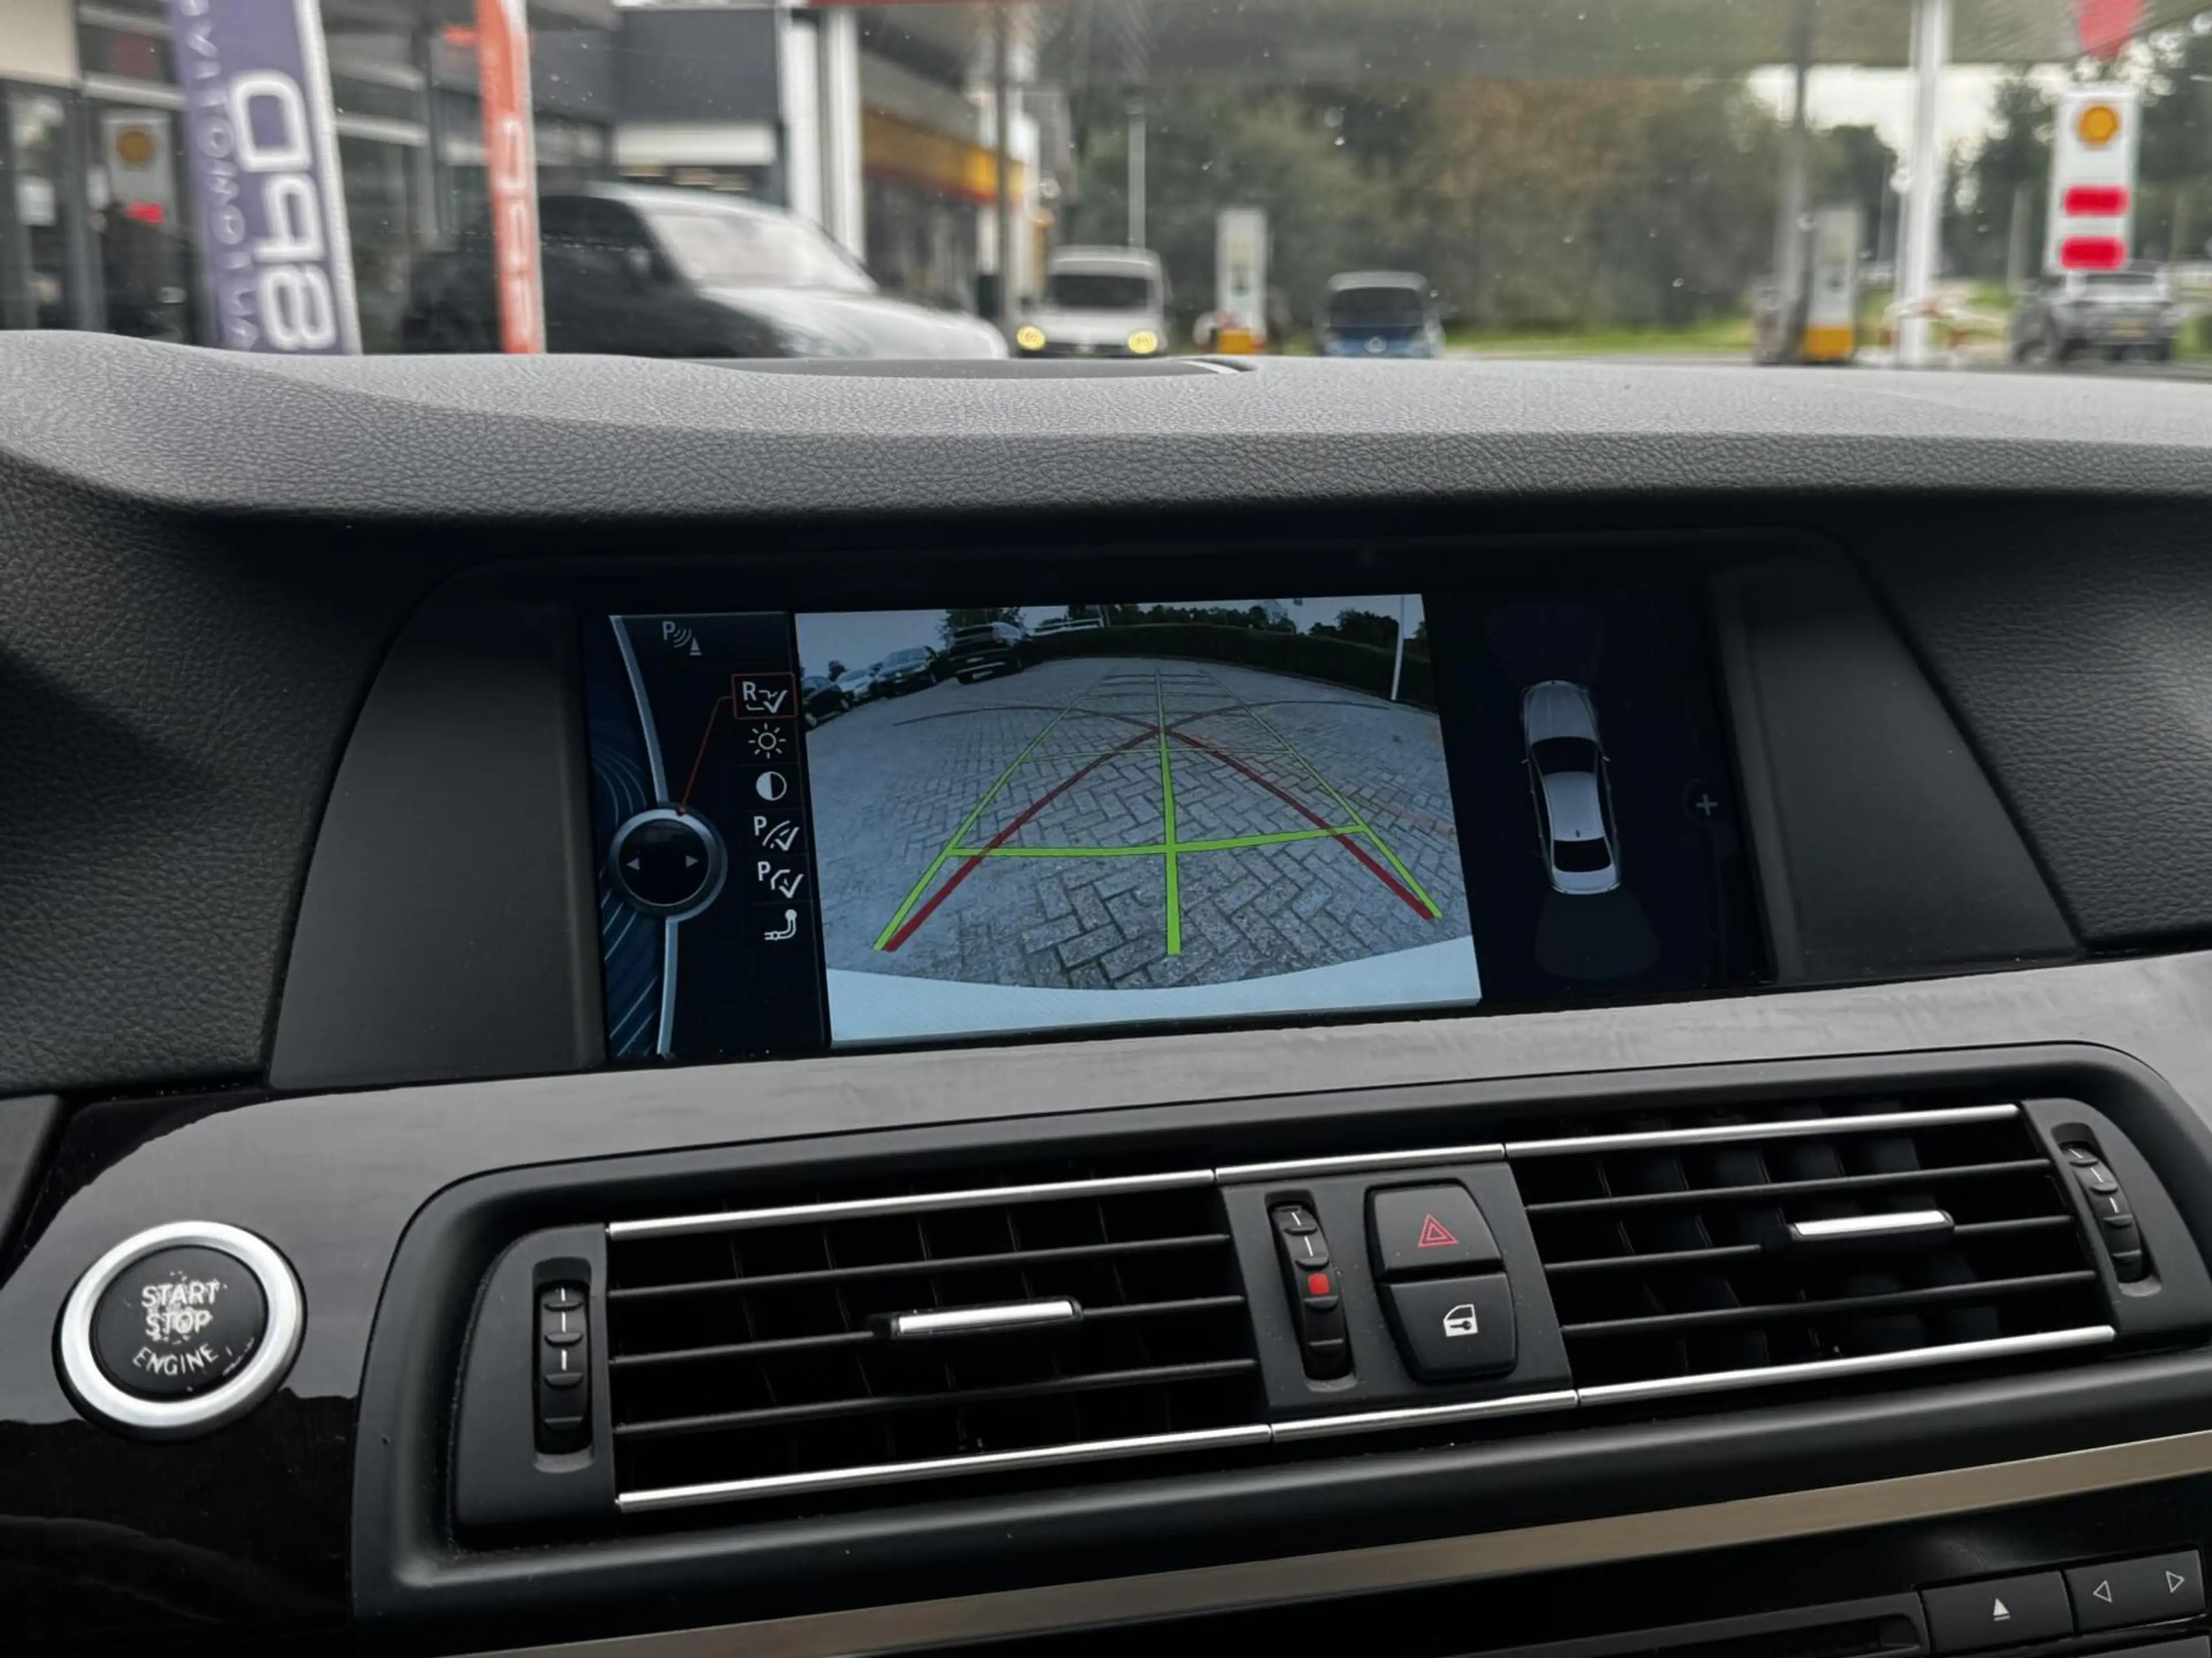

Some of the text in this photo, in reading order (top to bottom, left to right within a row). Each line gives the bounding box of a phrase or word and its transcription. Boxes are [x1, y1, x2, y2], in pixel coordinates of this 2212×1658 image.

[141, 1280, 221, 1307] START
[145, 1308, 214, 1336] STOP
[131, 1343, 219, 1376] ENGINE
